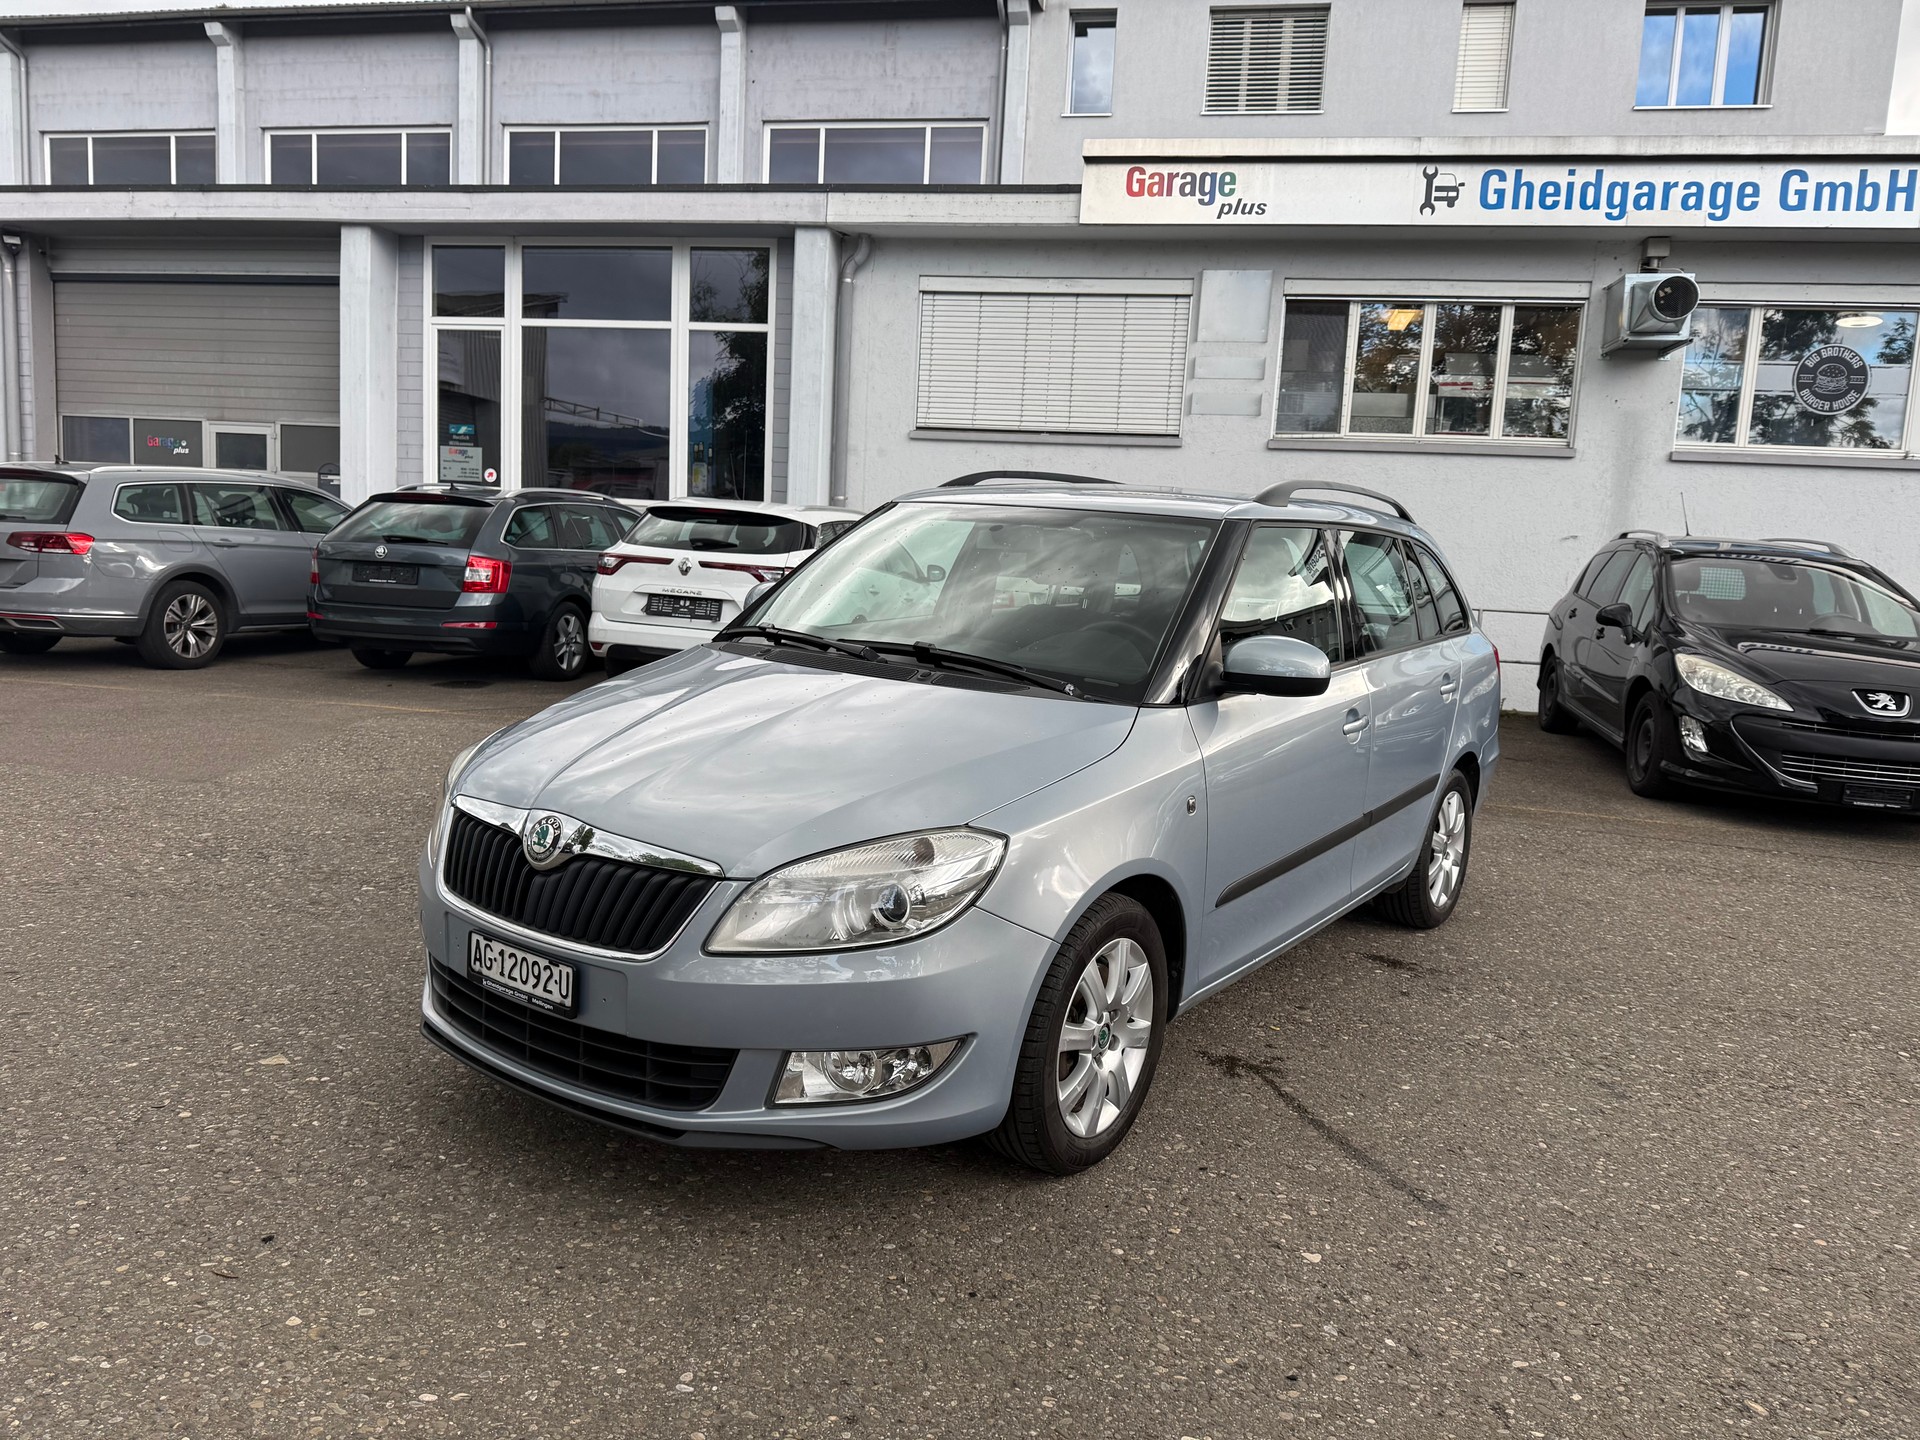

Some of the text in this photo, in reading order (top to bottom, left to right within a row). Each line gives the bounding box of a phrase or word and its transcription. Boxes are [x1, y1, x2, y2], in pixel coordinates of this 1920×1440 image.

[1126, 166, 1237, 206] Garage
[1479, 168, 1918, 221] Gheidgarage GmbH
[1216, 198, 1268, 219] plus
[1804, 347, 1864, 369] BIG BROTHERS
[1799, 388, 1861, 411] BURGER HOUSE
[173, 446, 189, 455] plus
[486, 980, 514, 996] Gheidgarage
[531, 997, 554, 1010] Mellingen
